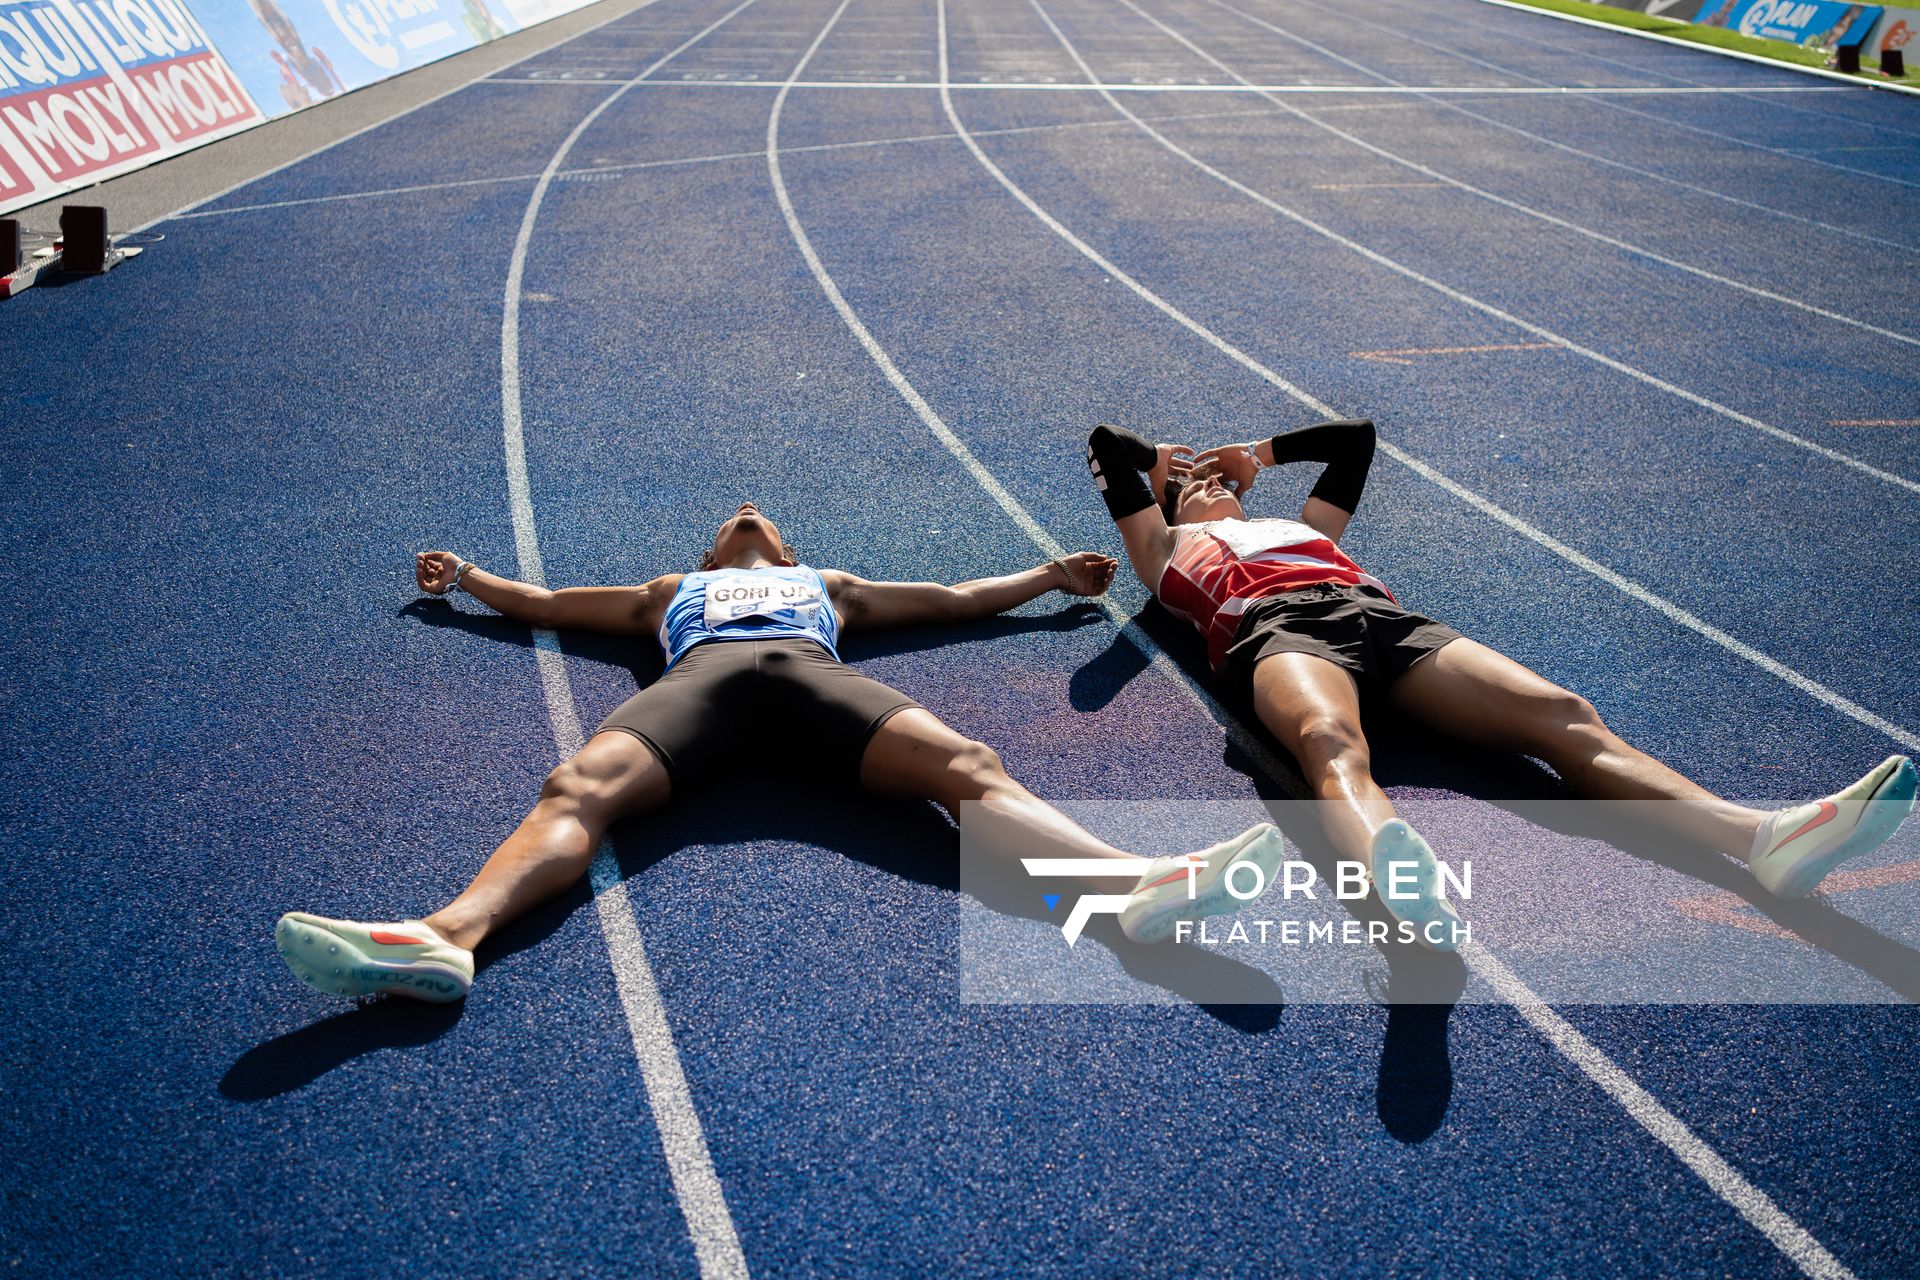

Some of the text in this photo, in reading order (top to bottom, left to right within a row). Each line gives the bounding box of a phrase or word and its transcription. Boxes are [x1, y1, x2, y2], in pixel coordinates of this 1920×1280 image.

[0, 6, 98, 90] QUI
[77, 0, 202, 62] LIQUI
[4, 82, 147, 175] MOLY
[135, 57, 246, 137] MOLY
